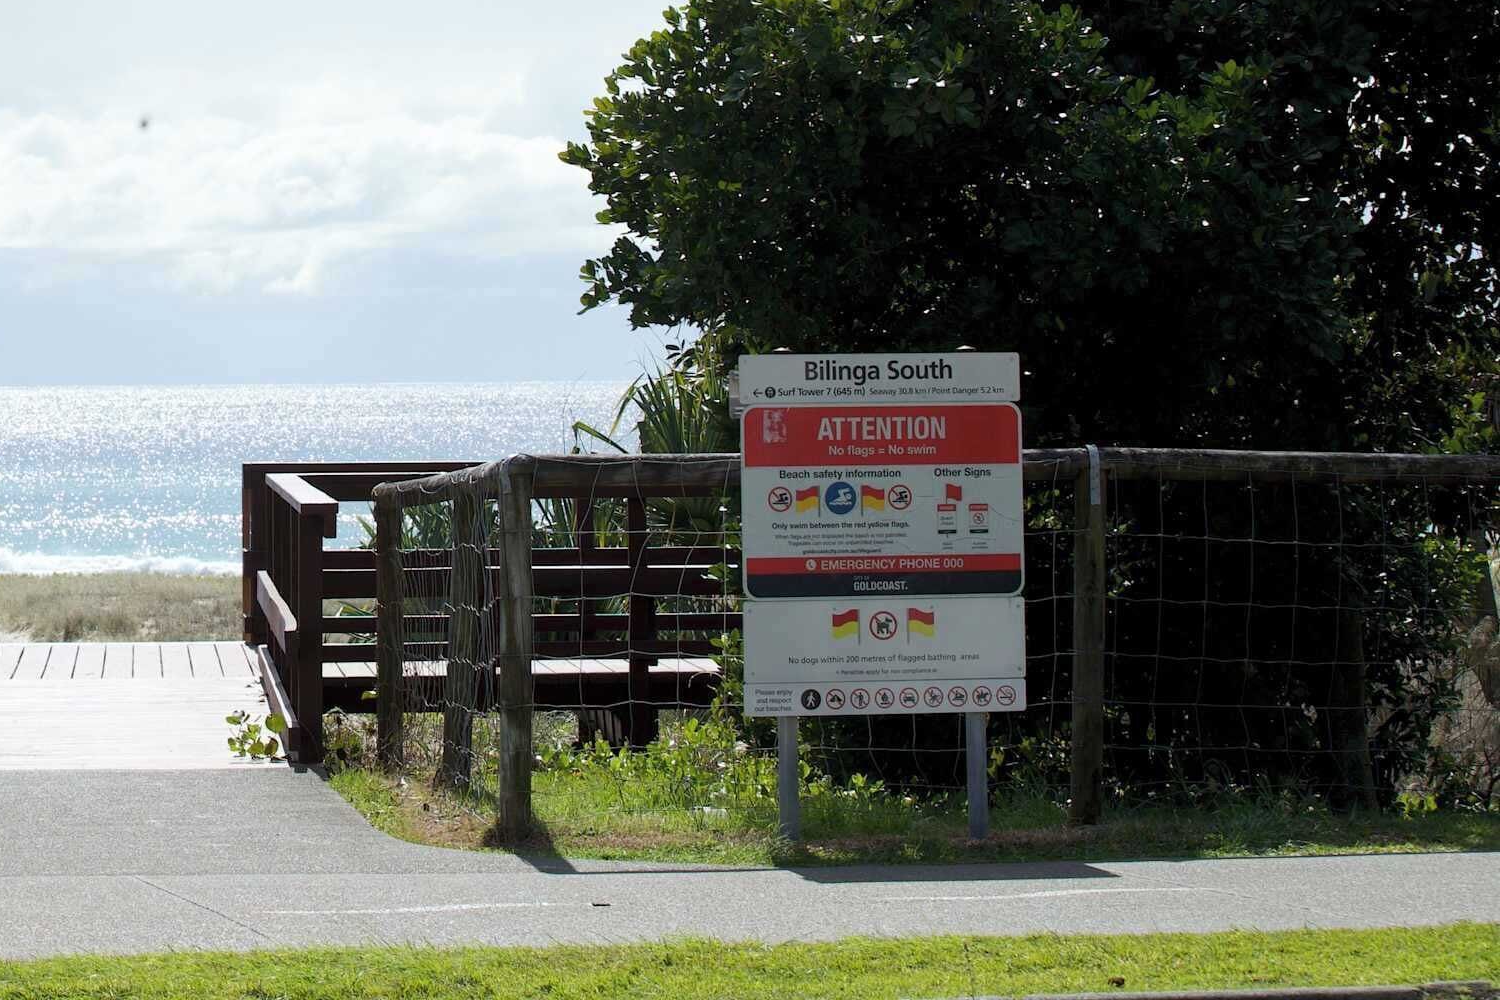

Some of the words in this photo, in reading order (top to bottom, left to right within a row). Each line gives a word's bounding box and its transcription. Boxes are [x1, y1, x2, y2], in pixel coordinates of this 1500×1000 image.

[805, 360, 880, 386] Bilinga
[887, 359, 953, 380] South
[778, 387, 796, 397] Surf
[799, 387, 825, 396] Tower
[826, 387, 832, 396] 7
[833, 386, 853, 398] (645
[854, 386, 866, 397] m)
[869, 387, 896, 396] Seaway
[932, 386, 951, 394] Point
[953, 386, 979, 396] Danger
[992, 386, 1005, 394] km
[817, 416, 946, 441] ATTENTION
[829, 445, 845, 456] No
[847, 445, 875, 457] flags
[888, 444, 904, 455] No
[907, 444, 937, 455] swim
[779, 470, 811, 479] Beach
[813, 469, 844, 480] safety
[845, 468, 902, 479] information
[934, 467, 962, 477] Other
[964, 466, 992, 479] Signs
[771, 521, 788, 531] Only
[790, 520, 808, 530] swim
[809, 520, 840, 529] between
[841, 520, 853, 529] the
[854, 520, 866, 528] red
[867, 520, 890, 530] yellow
[820, 559, 896, 571] EMERGENCY
[899, 558, 942, 570] PHONE
[943, 557, 965, 569] 000
[788, 656, 800, 665] No
[801, 655, 819, 667] dogs
[821, 655, 845, 664] within
[846, 655, 860, 664] 200
[861, 655, 886, 664] metres
[887, 654, 896, 663] of
[897, 653, 926, 665] flagged
[927, 652, 957, 664] bathing
[961, 654, 980, 662] areas
